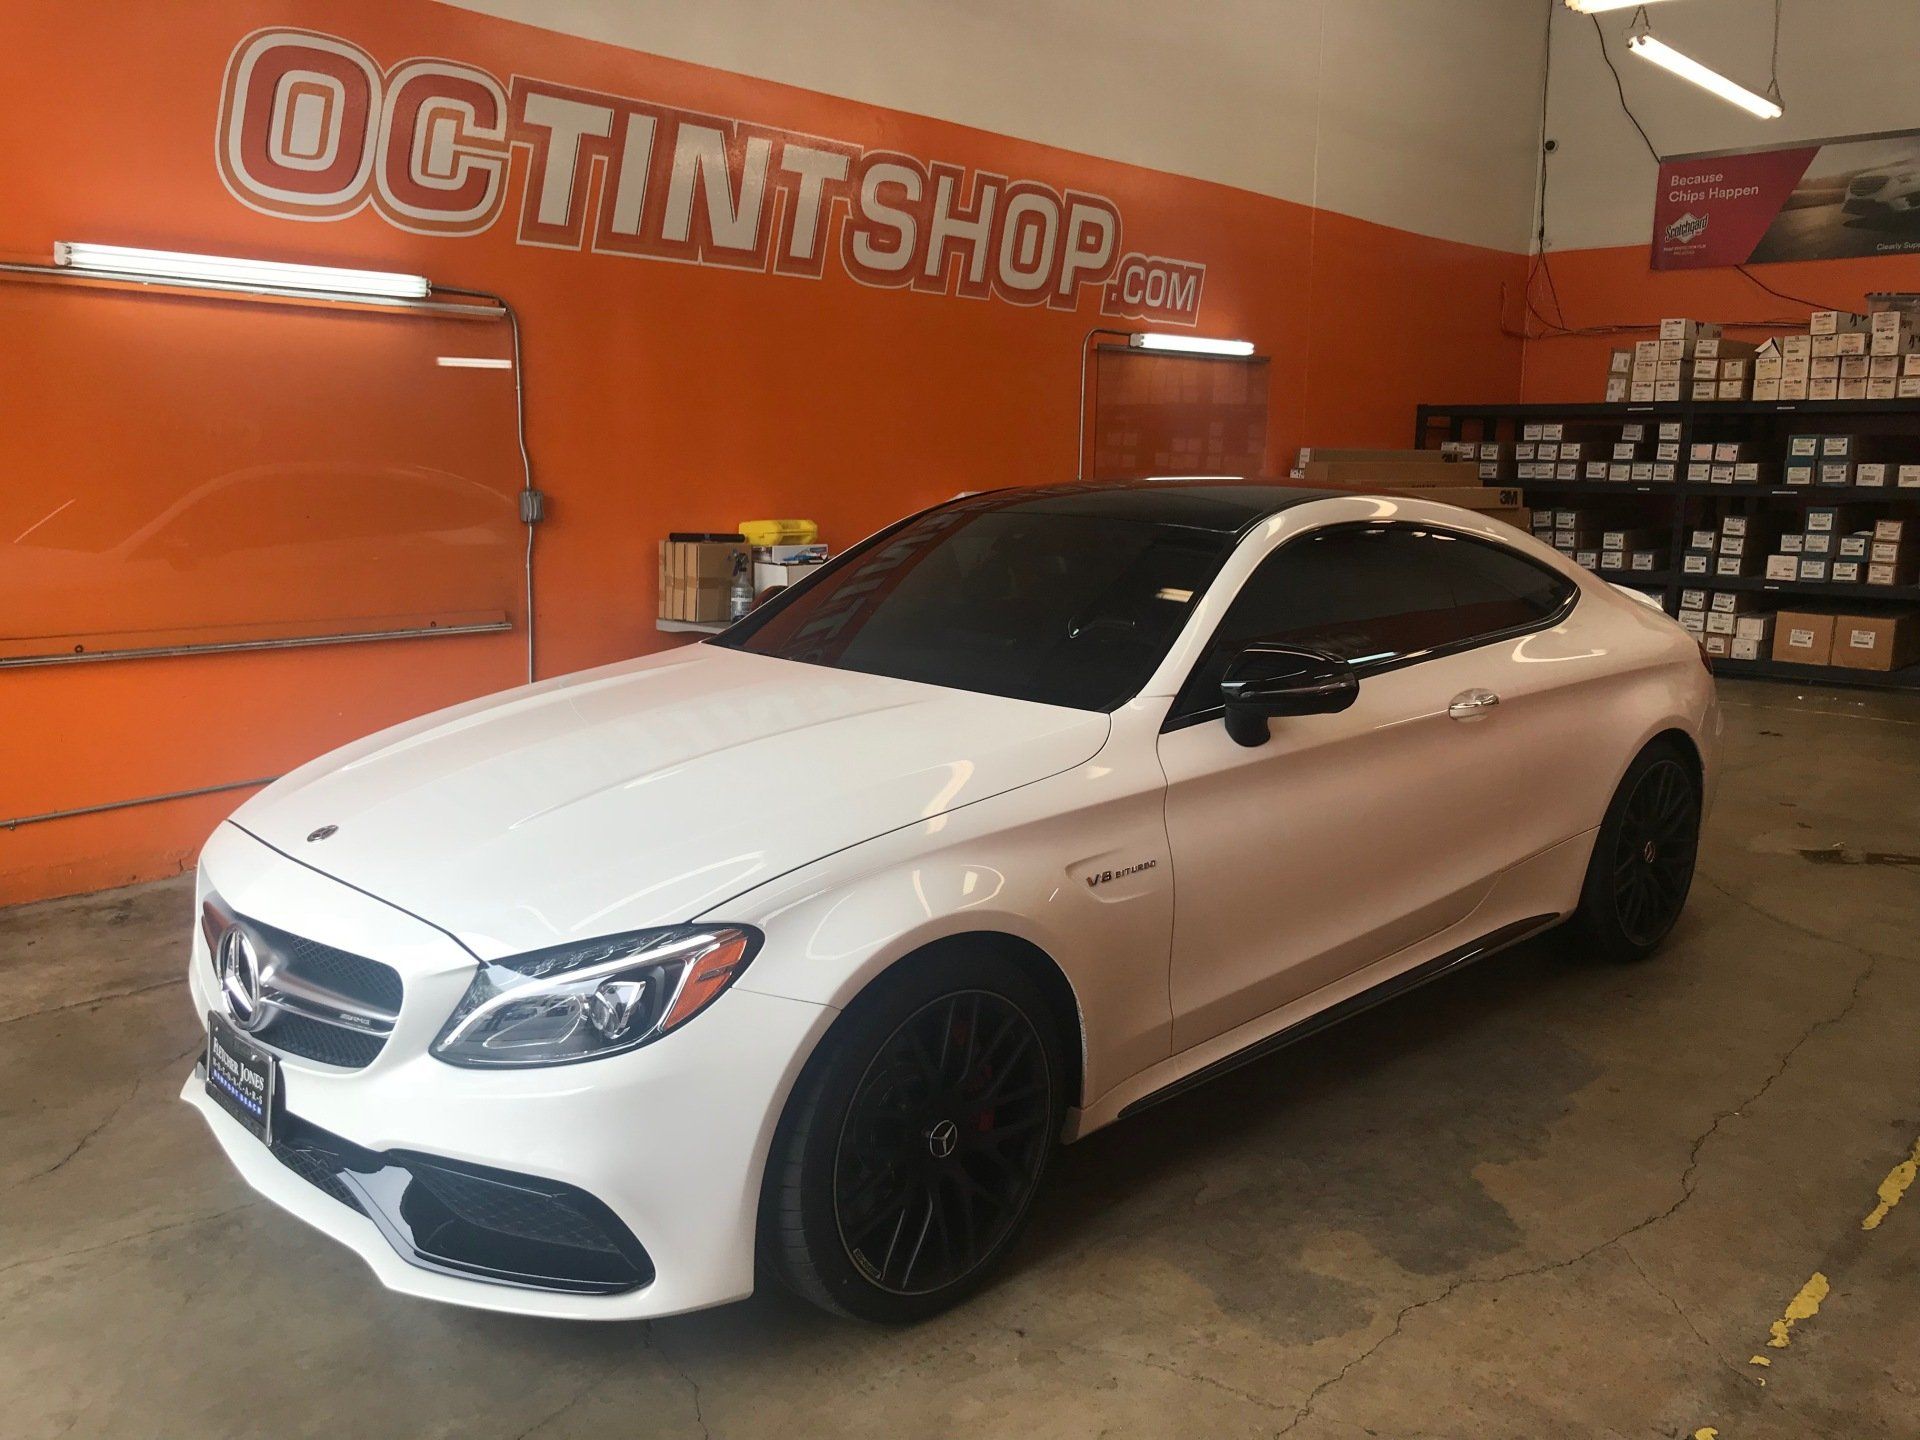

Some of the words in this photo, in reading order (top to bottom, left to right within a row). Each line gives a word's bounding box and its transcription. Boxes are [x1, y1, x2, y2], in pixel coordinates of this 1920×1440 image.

[1671, 173, 1724, 186] Because
[1668, 190, 1705, 203] Chips
[1709, 186, 1759, 200] Happen
[1664, 214, 1709, 242] Scotchgard
[1876, 242, 1902, 251] Clearly
[1500, 490, 1518, 506] 3M
[1086, 870, 1112, 887] V8
[1115, 861, 1156, 878] BITURBO
[213, 1036, 240, 1076] FLETCHER
[240, 1062, 265, 1091] JONES
